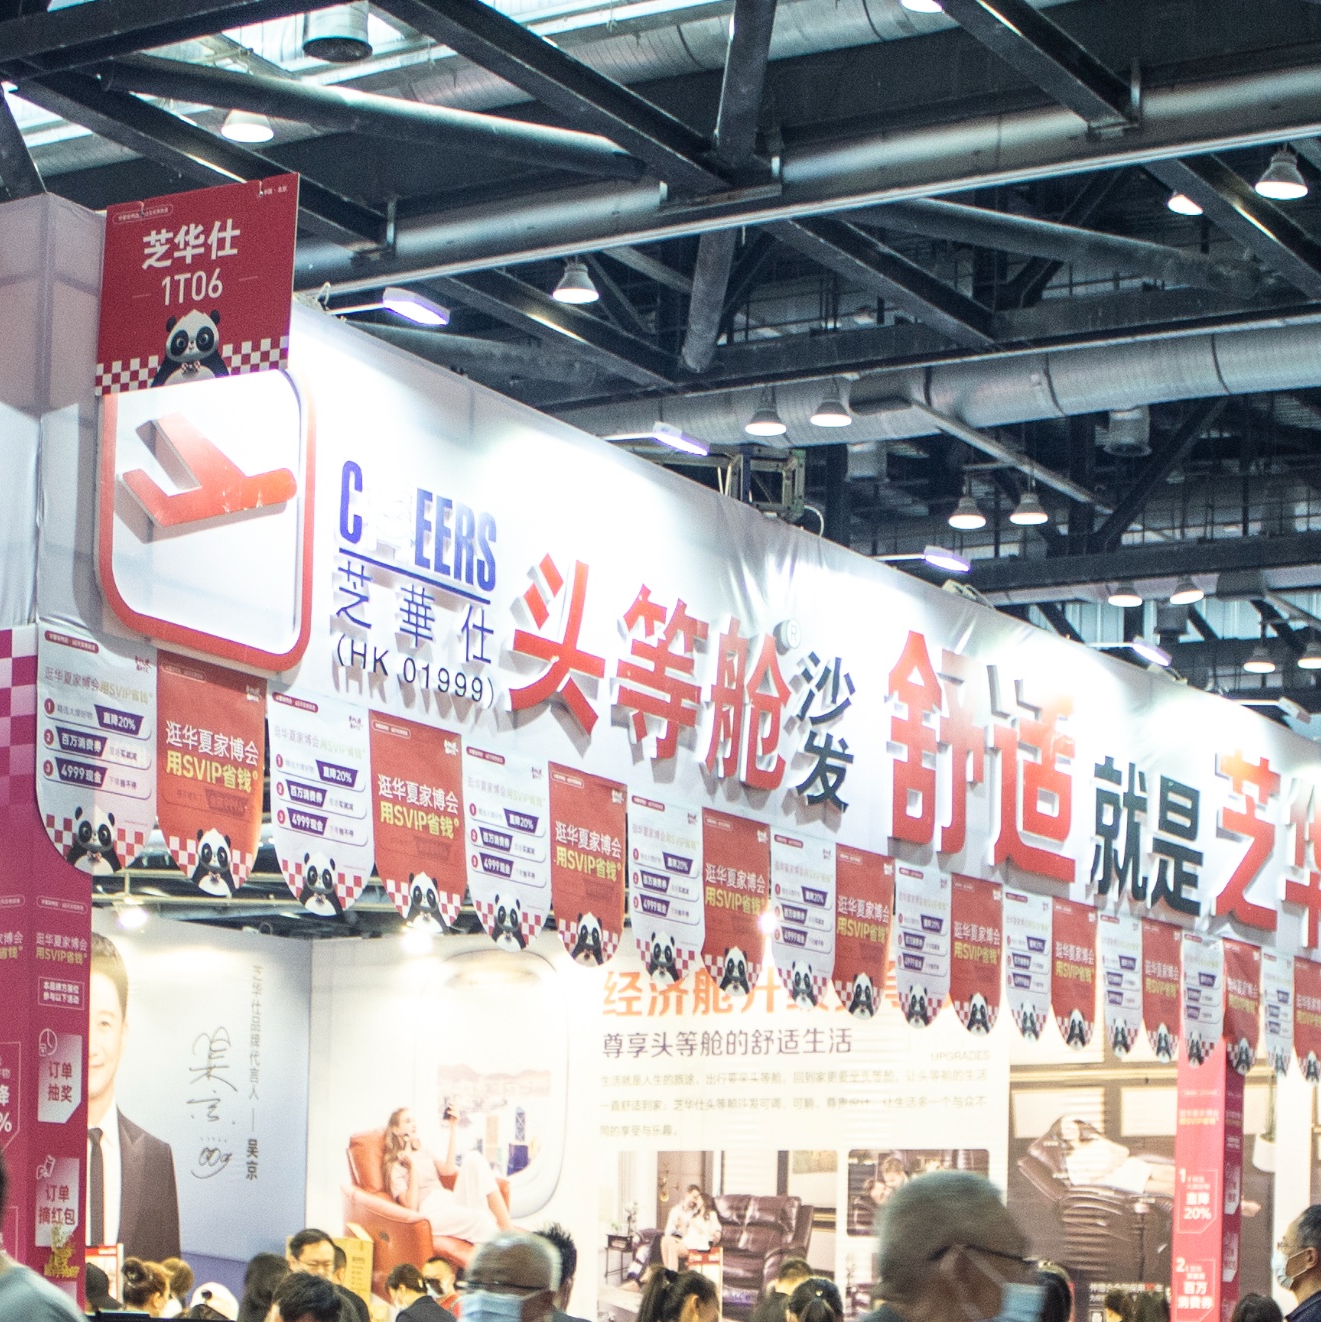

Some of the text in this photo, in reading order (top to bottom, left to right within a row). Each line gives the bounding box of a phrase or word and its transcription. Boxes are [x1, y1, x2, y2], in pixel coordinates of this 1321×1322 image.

[142, 219, 240, 269] 芝华仕
[162, 268, 223, 305] 1T06
[336, 560, 493, 664] 芝華仕
[337, 639, 495, 710] (HK 01999)
[103, 712, 136, 731] 直降20%
[61, 733, 102, 753] 百万消费券
[166, 720, 259, 767] 逛华夏家博会
[61, 764, 102, 784] 4999现金
[322, 764, 352, 783] 直降20%
[290, 784, 323, 805] 百万消费券
[378, 774, 459, 815] 逛华夏家博会
[292, 813, 324, 833] 4999现金
[555, 821, 622, 859] 逛华夏家博会
[705, 863, 766, 895] 逛华夏家博会
[36, 932, 87, 952] 逛华夏家博会
[602, 1027, 853, 1060] 尊享头等舱的舒适生活
[48, 1062, 73, 1080] 订单
[48, 1082, 73, 1104] 抽奖
[45, 1183, 70, 1202] 订单
[38, 1204, 76, 1226] 摘红包
[1184, 1207, 1212, 1220] 20%
[1183, 1282, 1208, 1295] 百万
